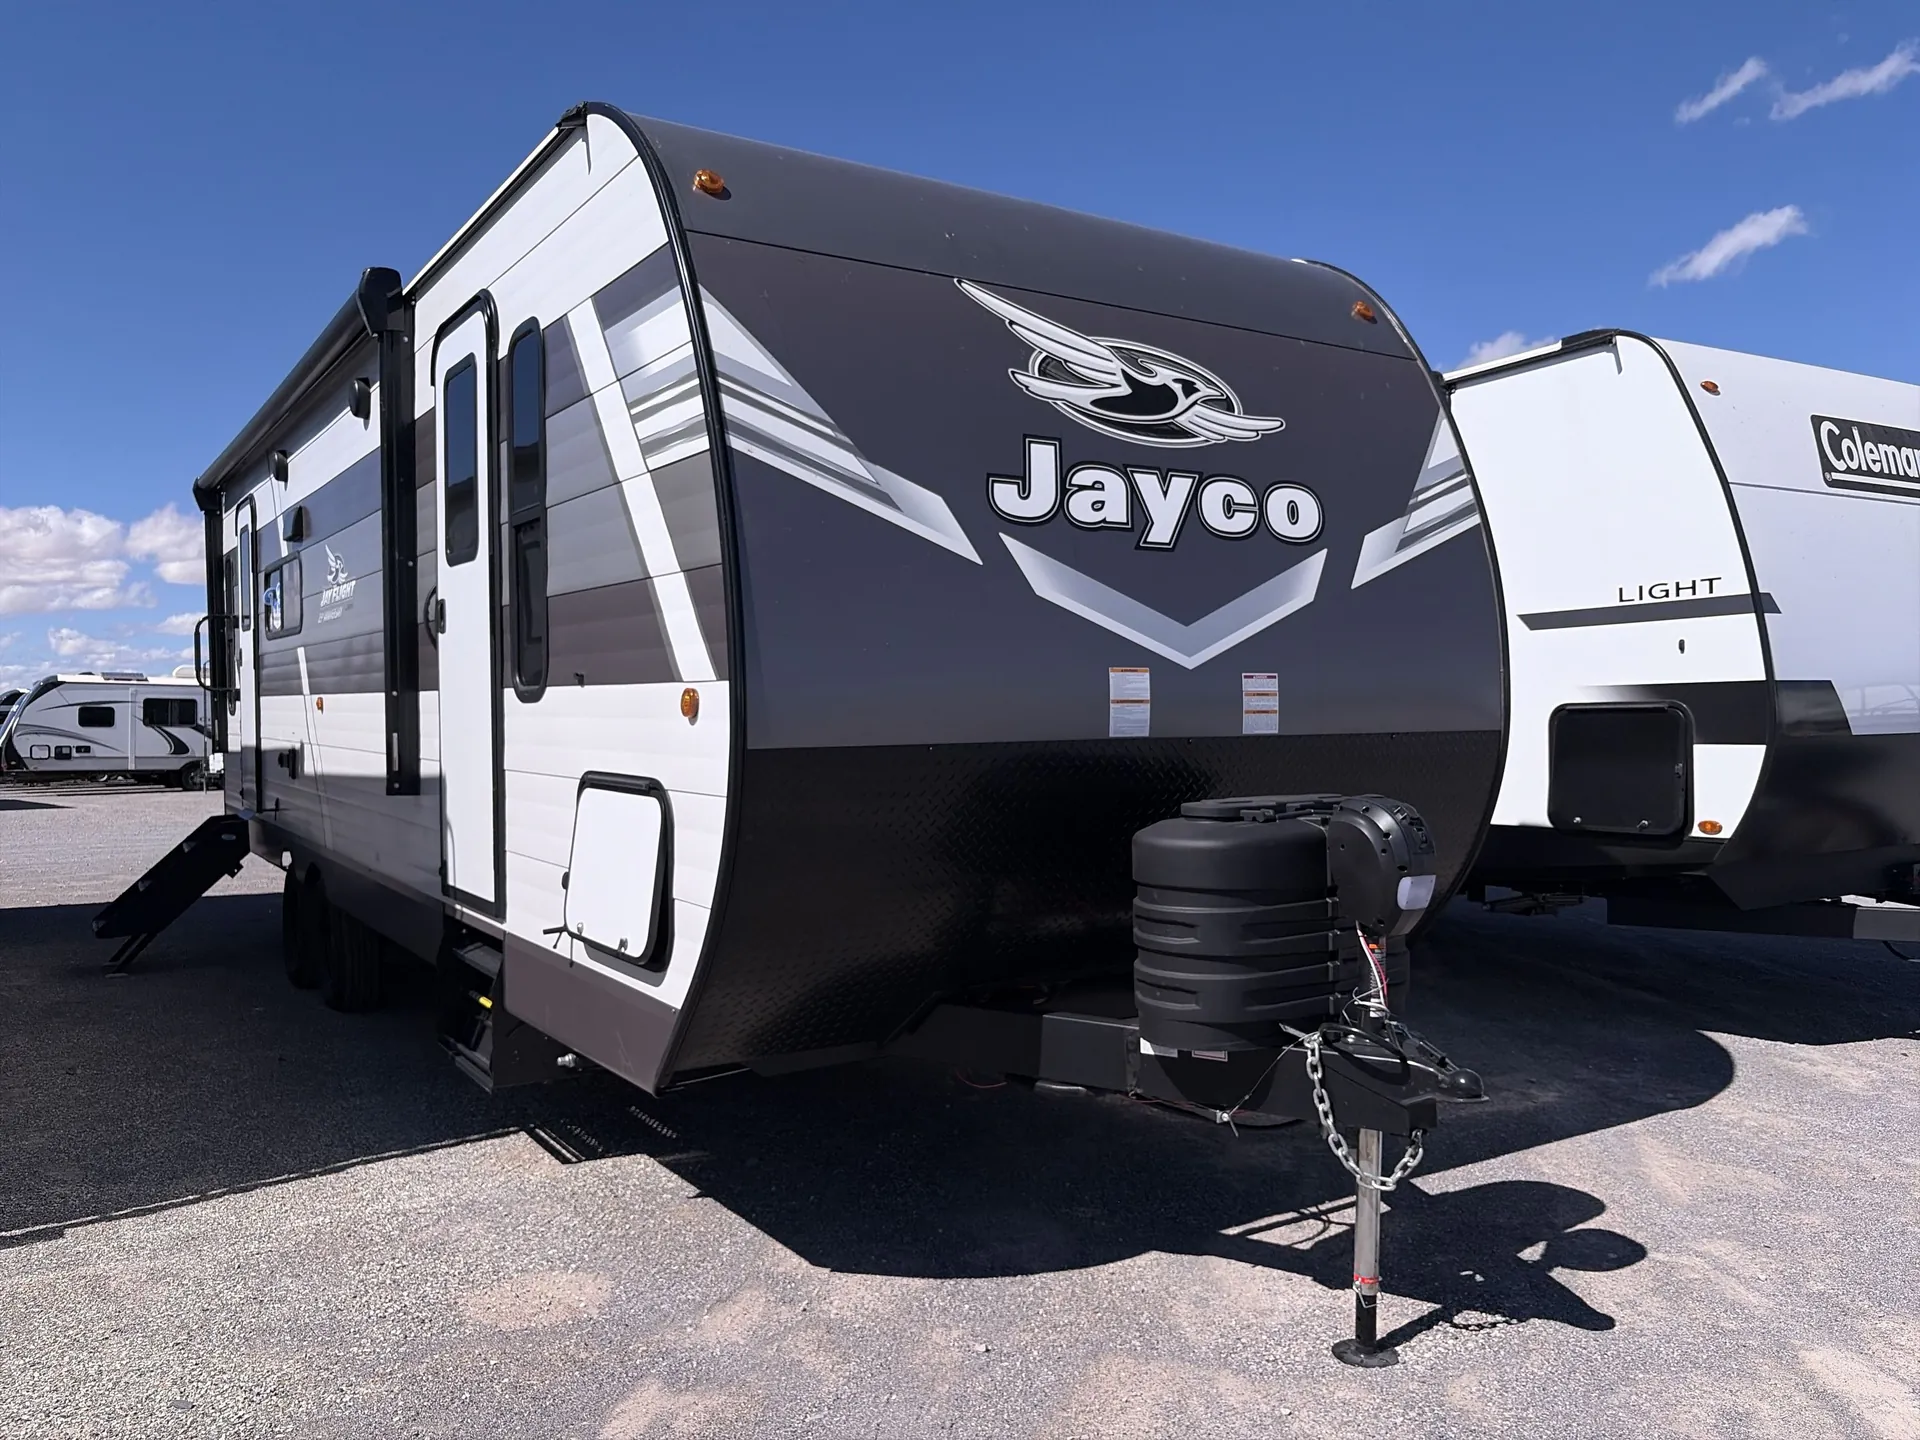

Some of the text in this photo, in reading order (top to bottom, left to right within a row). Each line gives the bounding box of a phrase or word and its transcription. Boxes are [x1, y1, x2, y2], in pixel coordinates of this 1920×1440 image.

[988, 436, 1326, 549] Jayco
[320, 589, 333, 608] JAY
[332, 580, 356, 603] FLIGHT
[1619, 577, 1722, 602] LIGHT
